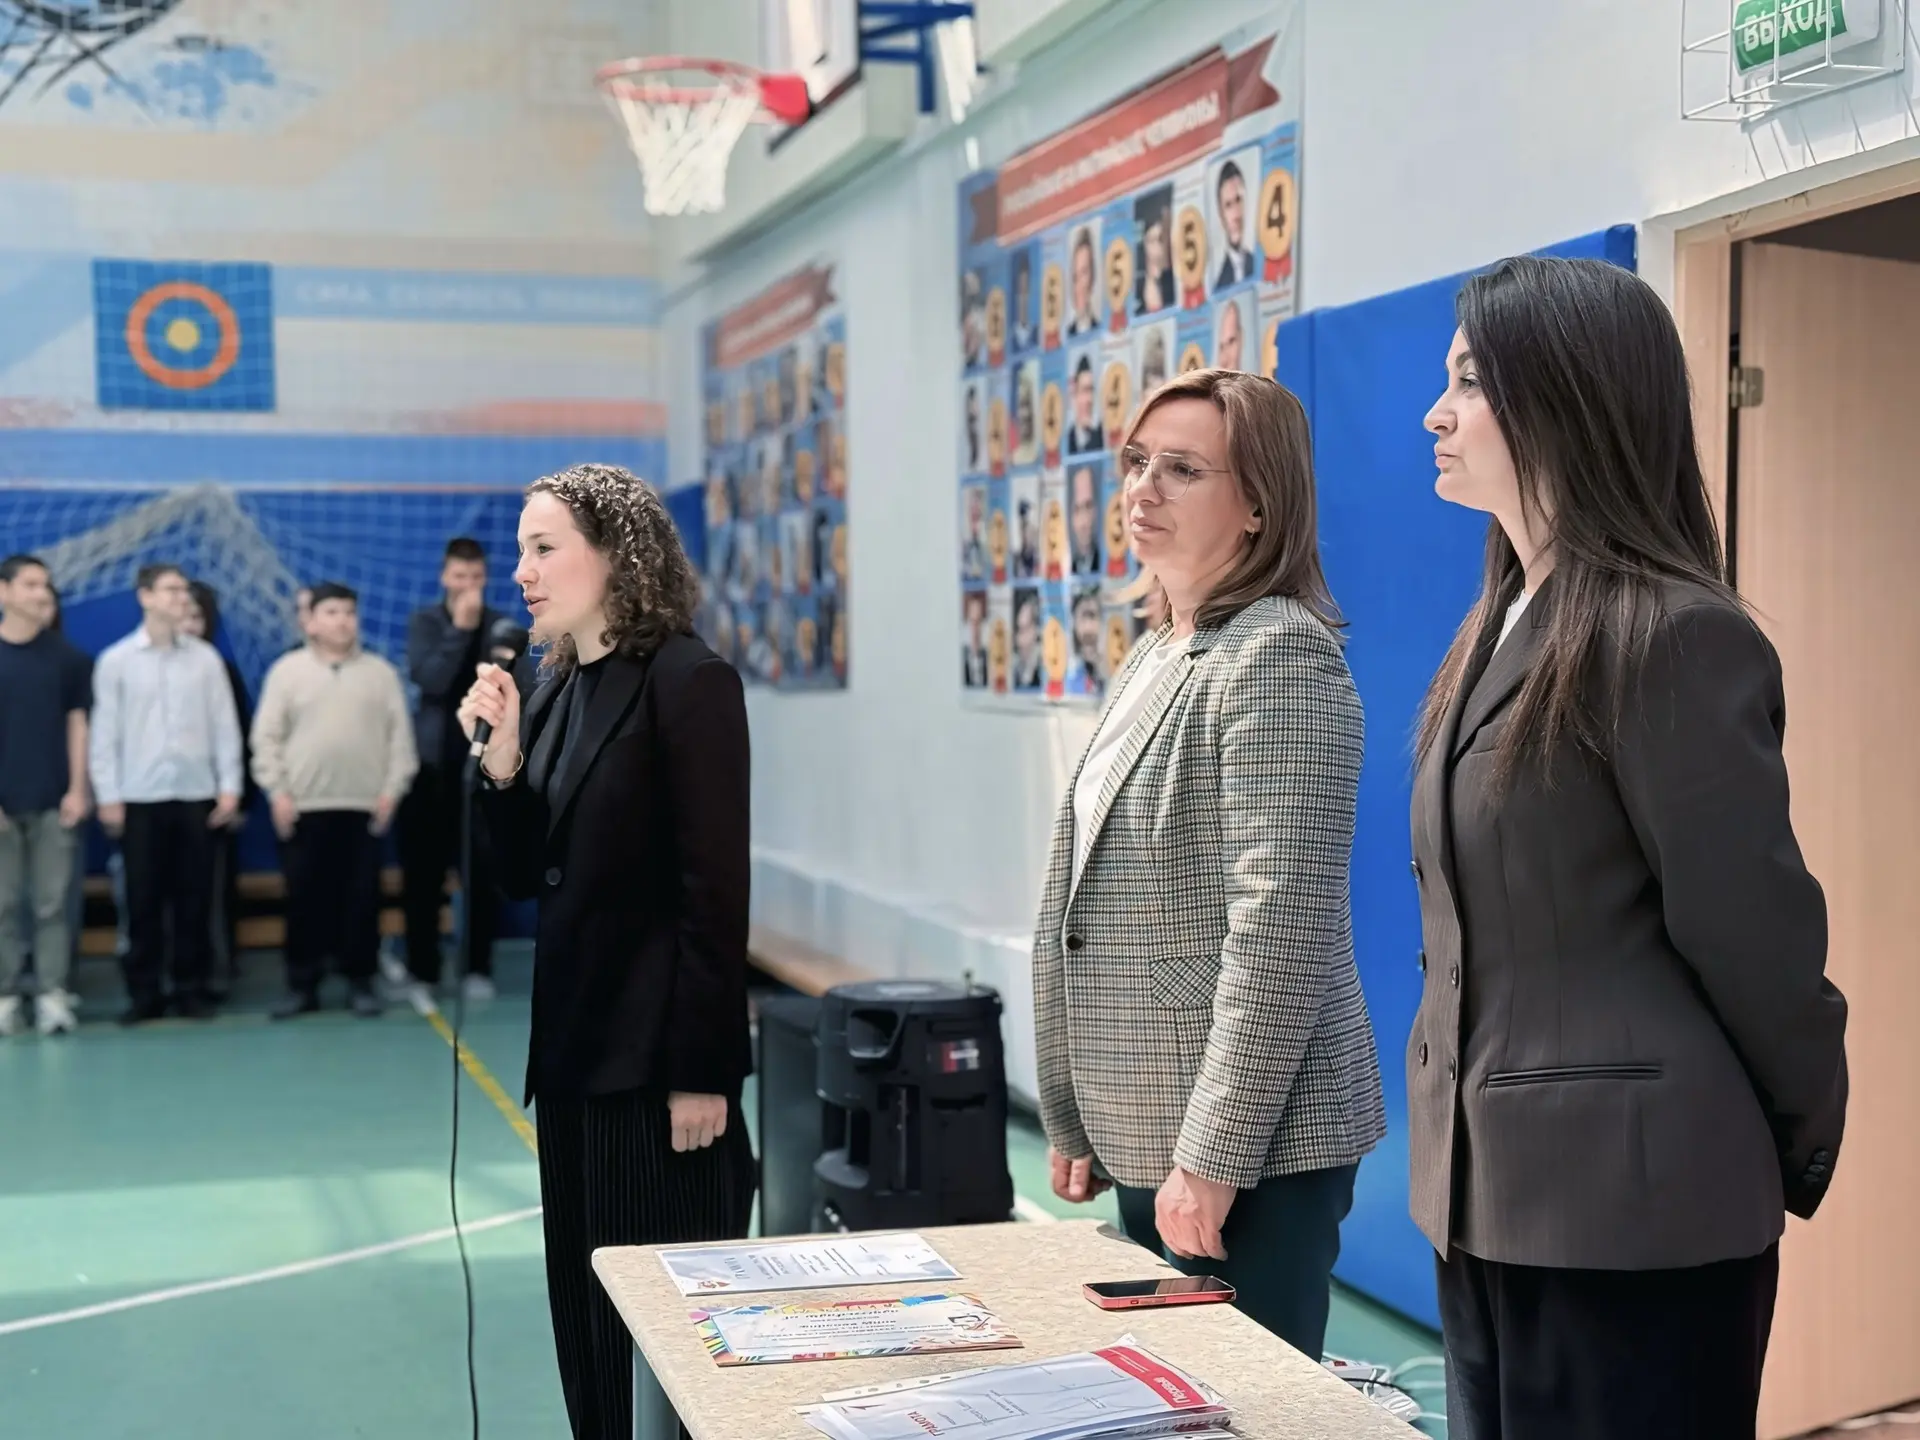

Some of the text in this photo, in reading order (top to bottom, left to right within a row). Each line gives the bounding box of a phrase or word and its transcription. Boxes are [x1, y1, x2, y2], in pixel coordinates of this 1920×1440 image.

[1744, 0, 1836, 52] ВЫХОД
[1265, 183, 1286, 238] 4
[1184, 220, 1199, 271] 5
[907, 1410, 946, 1437] ГРАМОТА
